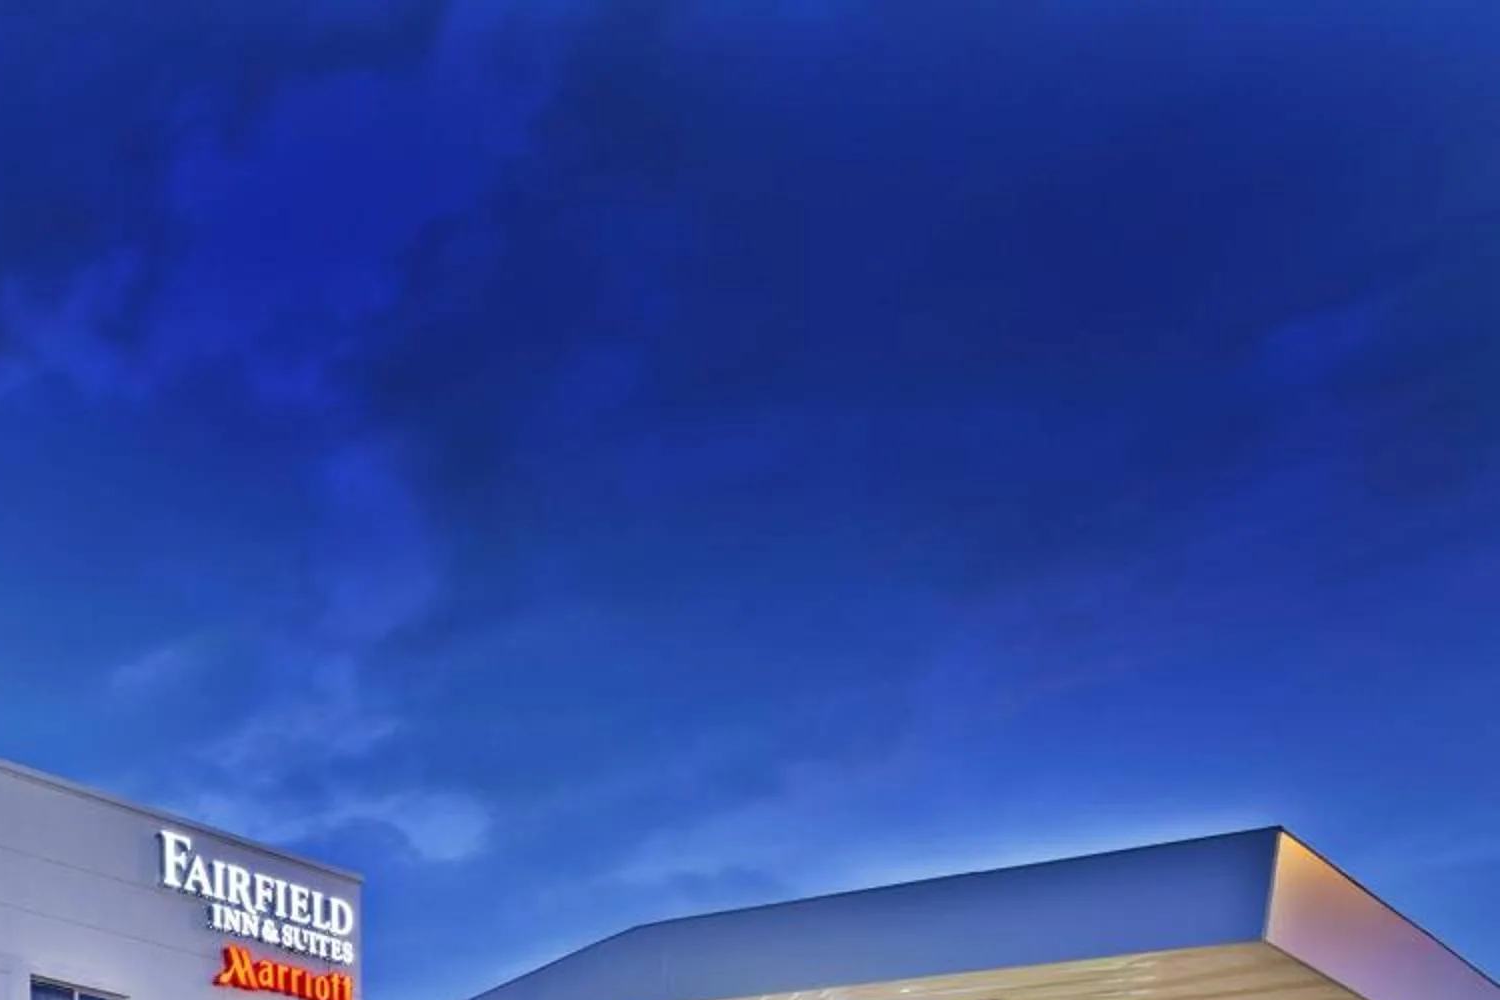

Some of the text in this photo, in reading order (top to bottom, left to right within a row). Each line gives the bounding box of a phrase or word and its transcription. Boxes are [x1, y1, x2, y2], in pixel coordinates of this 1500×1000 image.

[160, 830, 353, 935] FAIRFIELD
[211, 903, 354, 965] INN & SUITES
